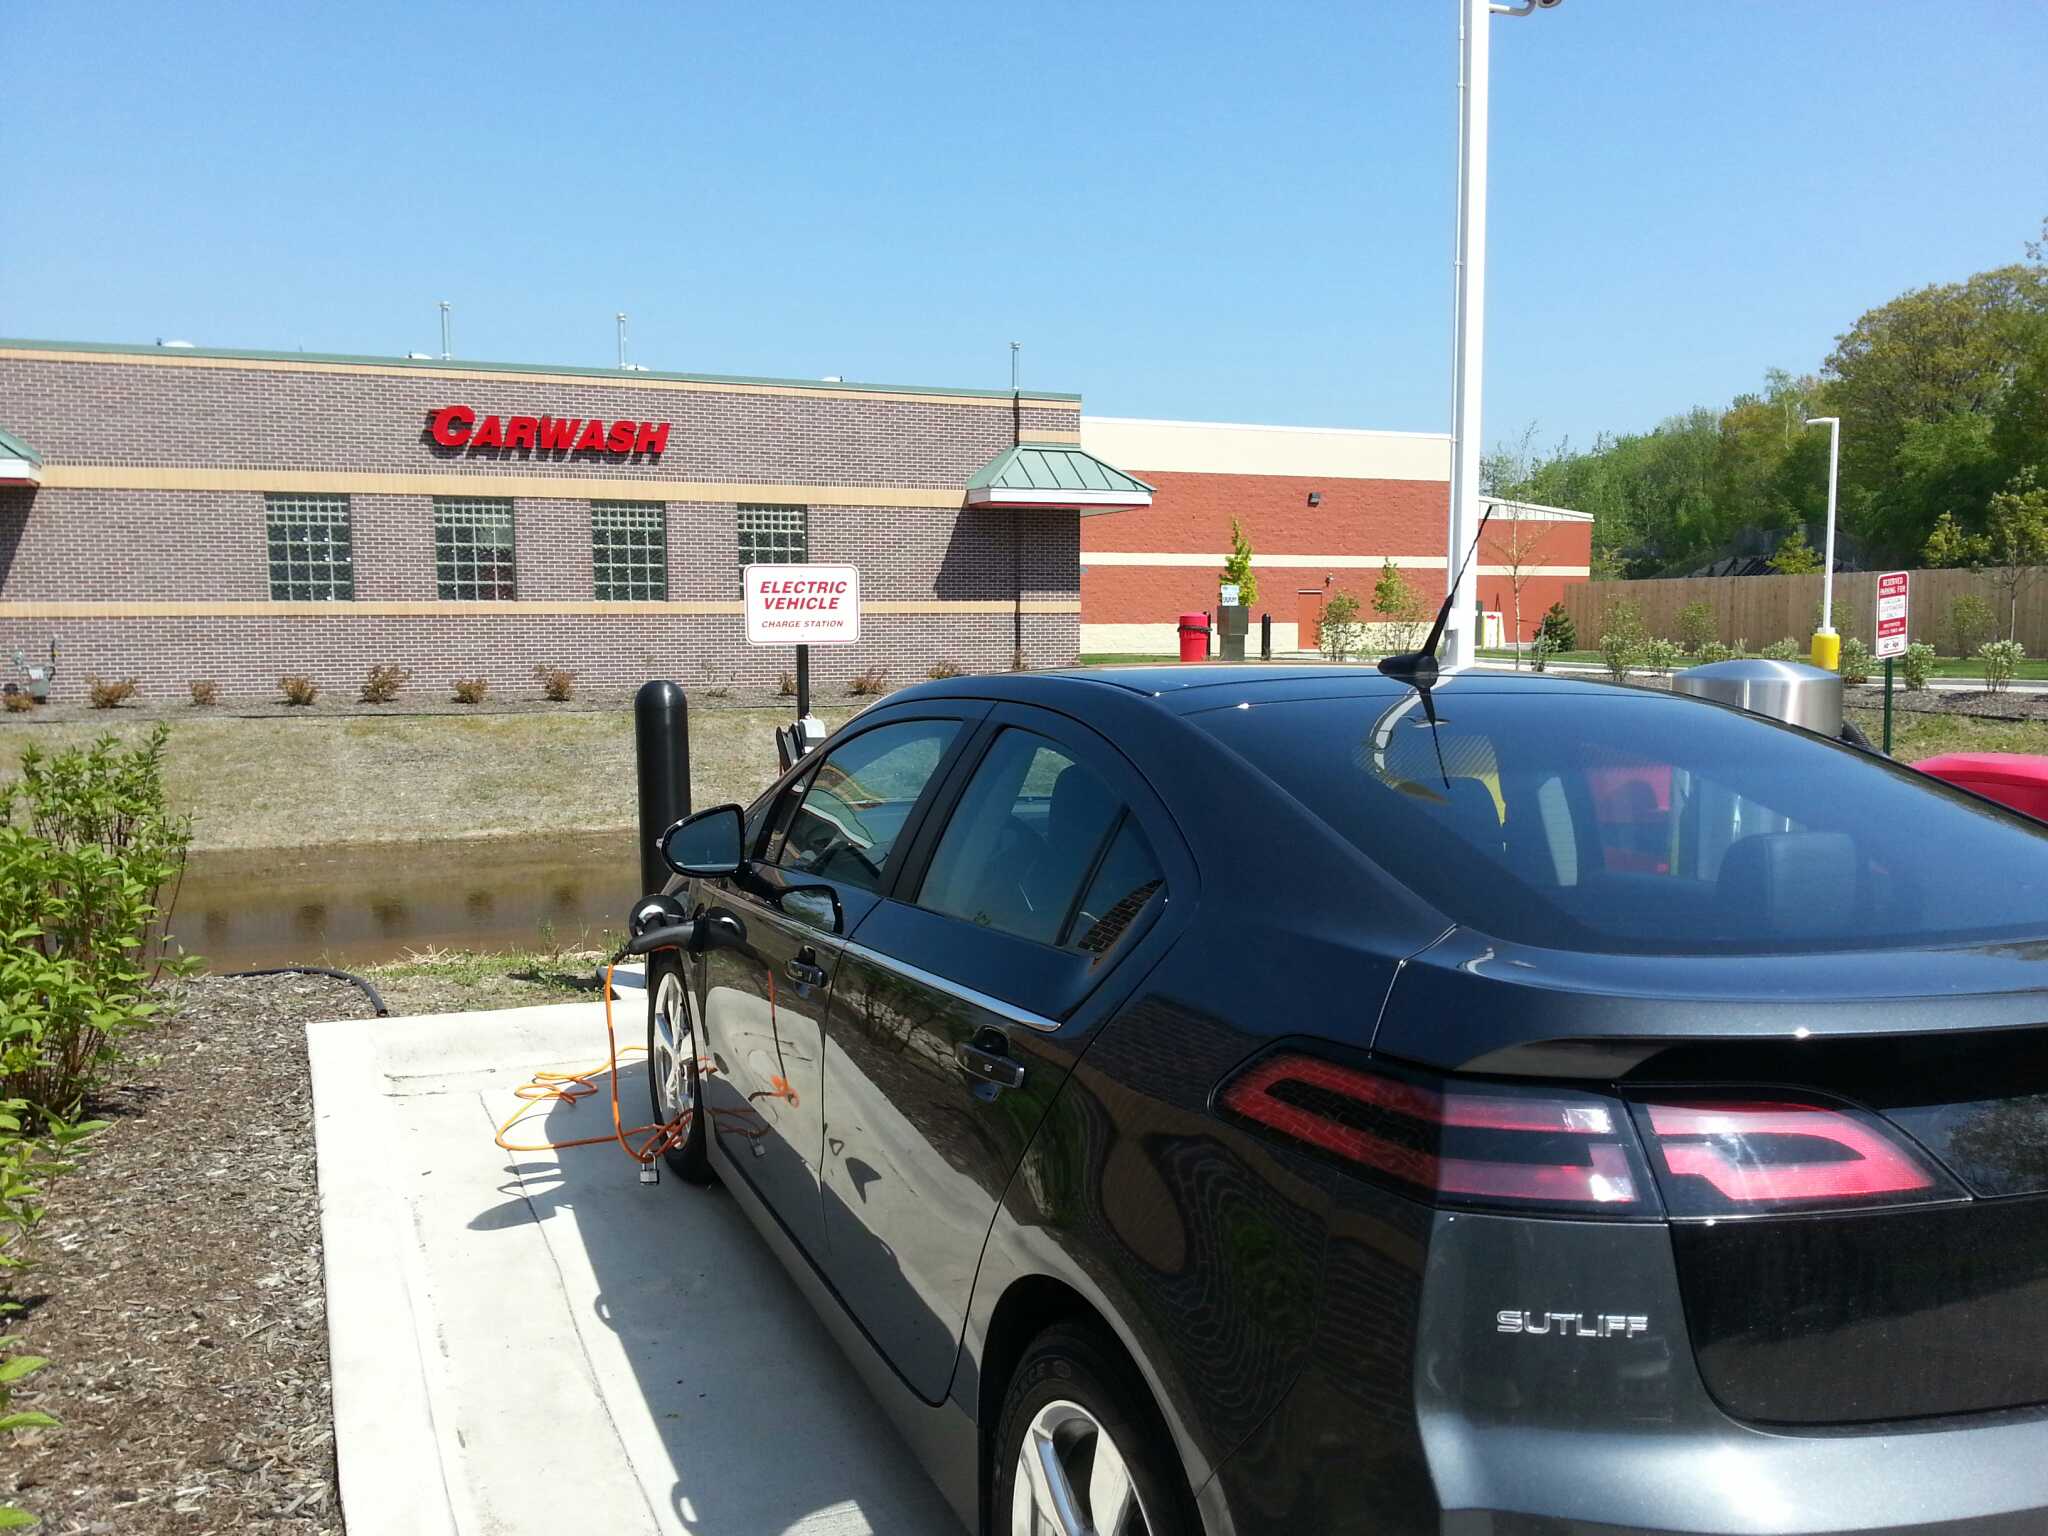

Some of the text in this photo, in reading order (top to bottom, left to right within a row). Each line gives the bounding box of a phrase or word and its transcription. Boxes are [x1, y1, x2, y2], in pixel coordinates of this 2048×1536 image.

[431, 405, 672, 454] CARWASH
[760, 581, 848, 594] ELECTRIC
[764, 597, 840, 610] VEHICLE
[761, 619, 844, 629] CHARGE STATION
[1496, 1310, 1649, 1338] SUTLIFF
